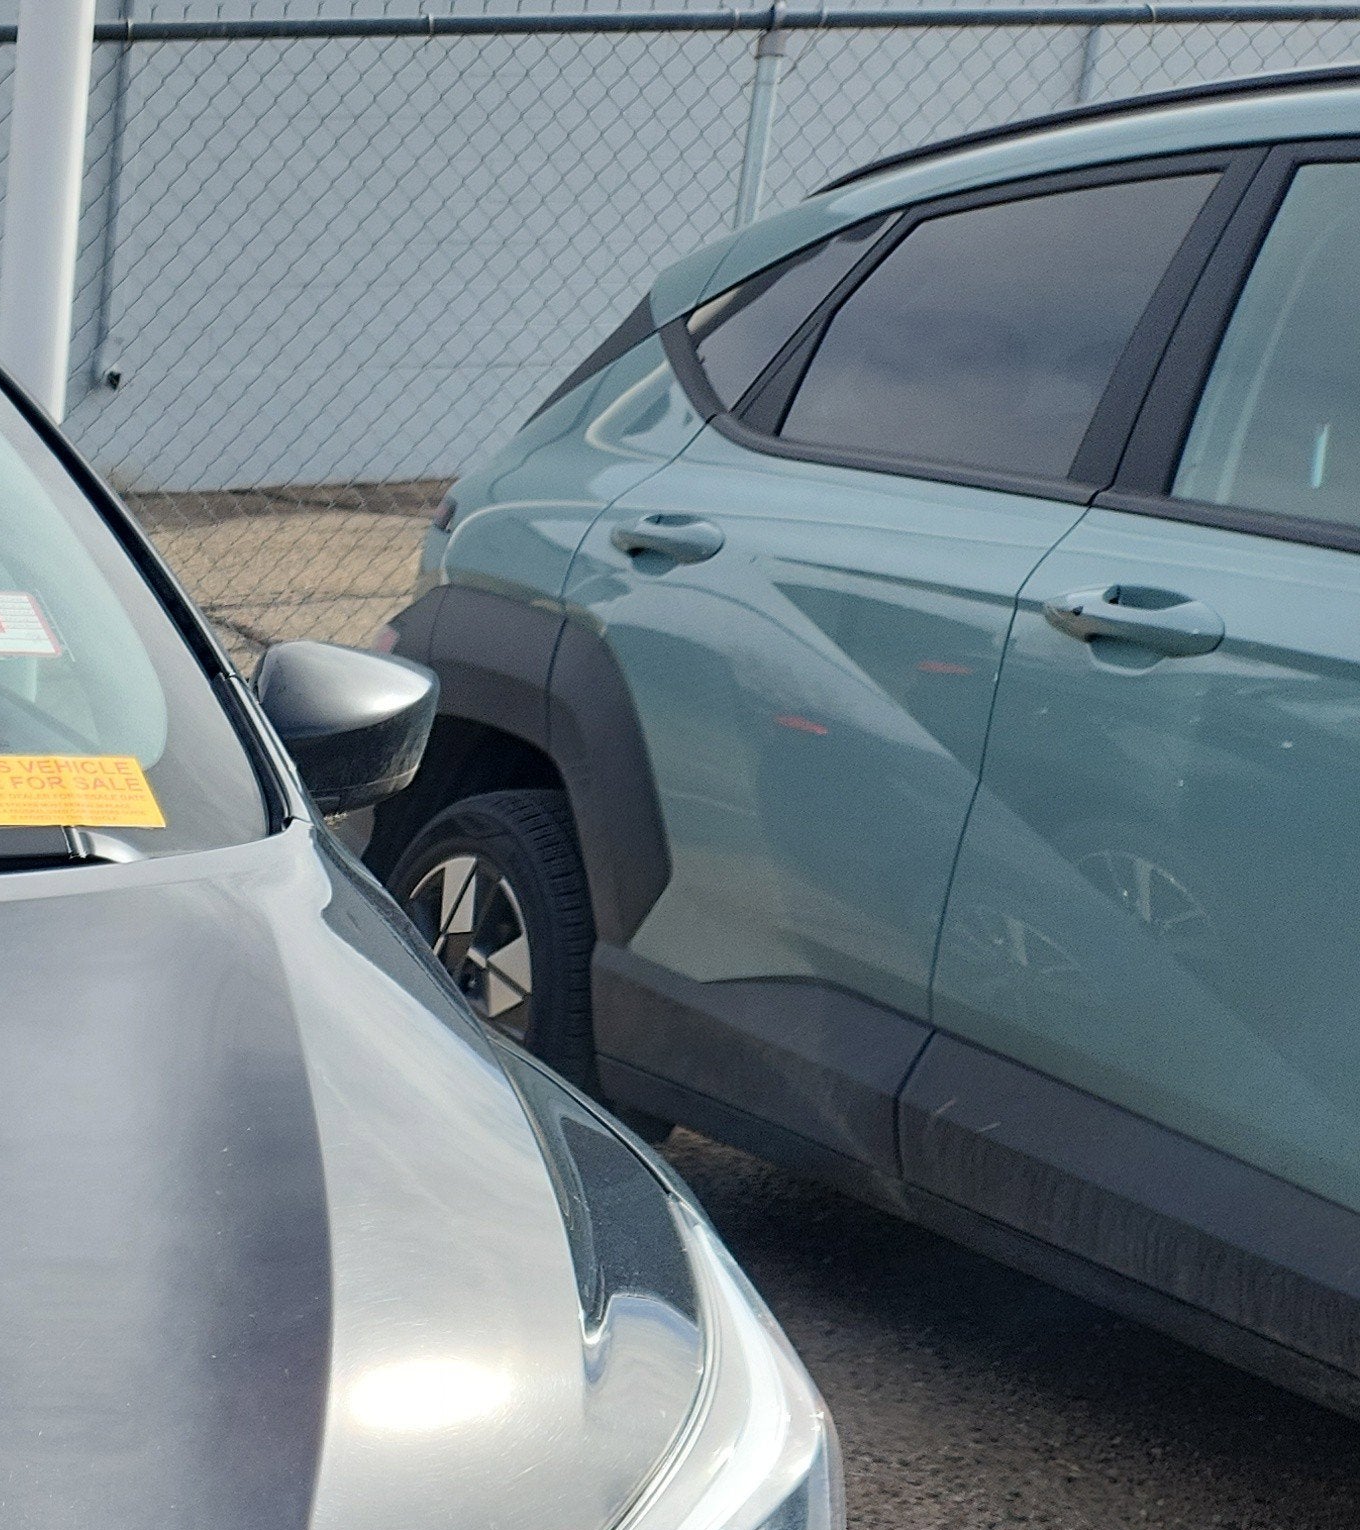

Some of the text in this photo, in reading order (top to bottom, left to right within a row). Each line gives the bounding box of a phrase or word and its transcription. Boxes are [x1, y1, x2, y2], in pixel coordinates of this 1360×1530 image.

[17, 760, 133, 775] VEHICLE
[10, 776, 66, 790] FOR
[73, 777, 143, 792] SALE
